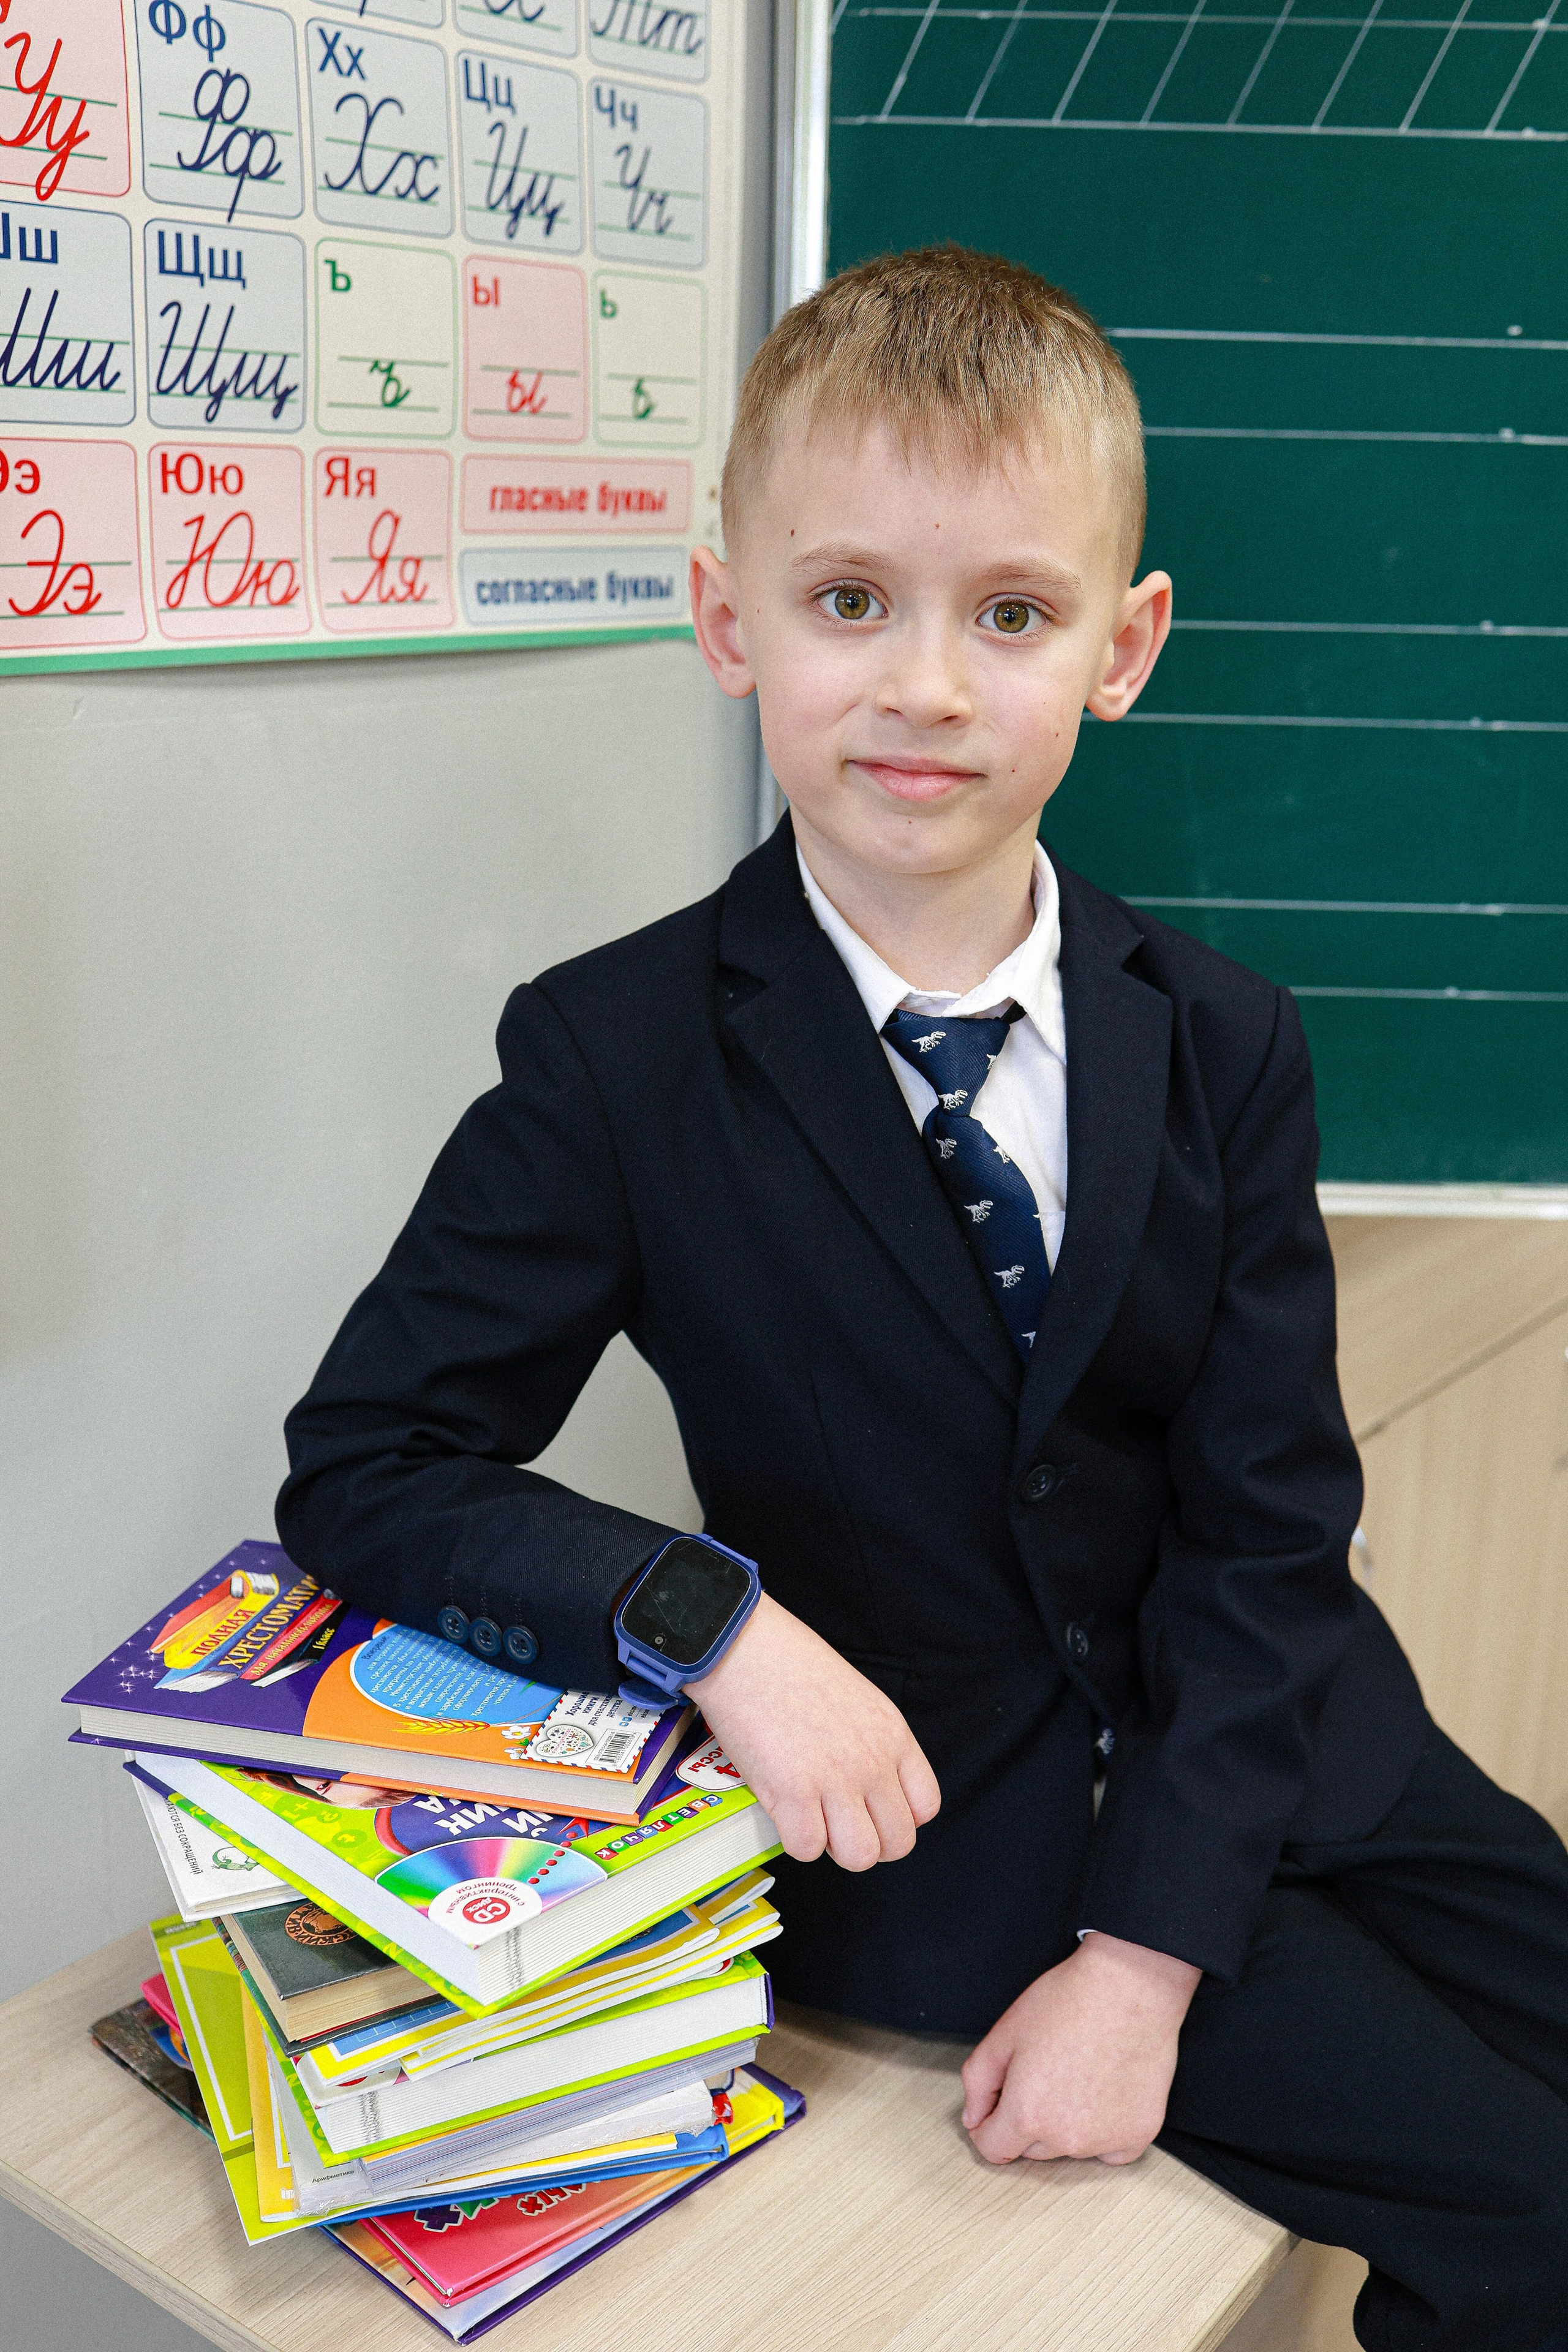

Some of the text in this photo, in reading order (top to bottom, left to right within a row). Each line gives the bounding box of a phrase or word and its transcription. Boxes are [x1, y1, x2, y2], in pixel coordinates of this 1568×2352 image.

[149, 0, 226, 62] Фф
[318, 28, 368, 81] Хх
[464, 59, 515, 115] Цц
[595, 86, 638, 131] Чч
[0, 32, 90, 201] Уу
[176, 69, 282, 223] Фф
[325, 93, 440, 203] Хх
[488, 121, 564, 238] Цц
[157, 230, 246, 289] Щщ
[157, 301, 298, 422] Щщ
[161, 452, 244, 495] Юю
[324, 457, 377, 499] Яя
[489, 481, 666, 519] гласные буквы
[9, 510, 102, 617] Ээ
[165, 510, 300, 609] Юю
[341, 508, 429, 606] Яя
[476, 570, 674, 606] согласные буквы
[191, 1609, 255, 1655] ПОЛНАЯ
[315, 1627, 334, 1645] класс
[565, 1691, 590, 1716] Хорошие
[582, 1697, 600, 1713] книги
[588, 1716, 598, 1725] для
[606, 1700, 623, 1717] детства
[173, 1823, 184, 1834] БЕЗ
[595, 1795, 723, 1860] СВЕТЛЯЧОК
[178, 1834, 203, 1875] СОКРАЩЕНИЙ
[456, 1882, 518, 1894] тренингом
[473, 1902, 507, 1923] CD
[312, 2170, 355, 2183] Арифметика
